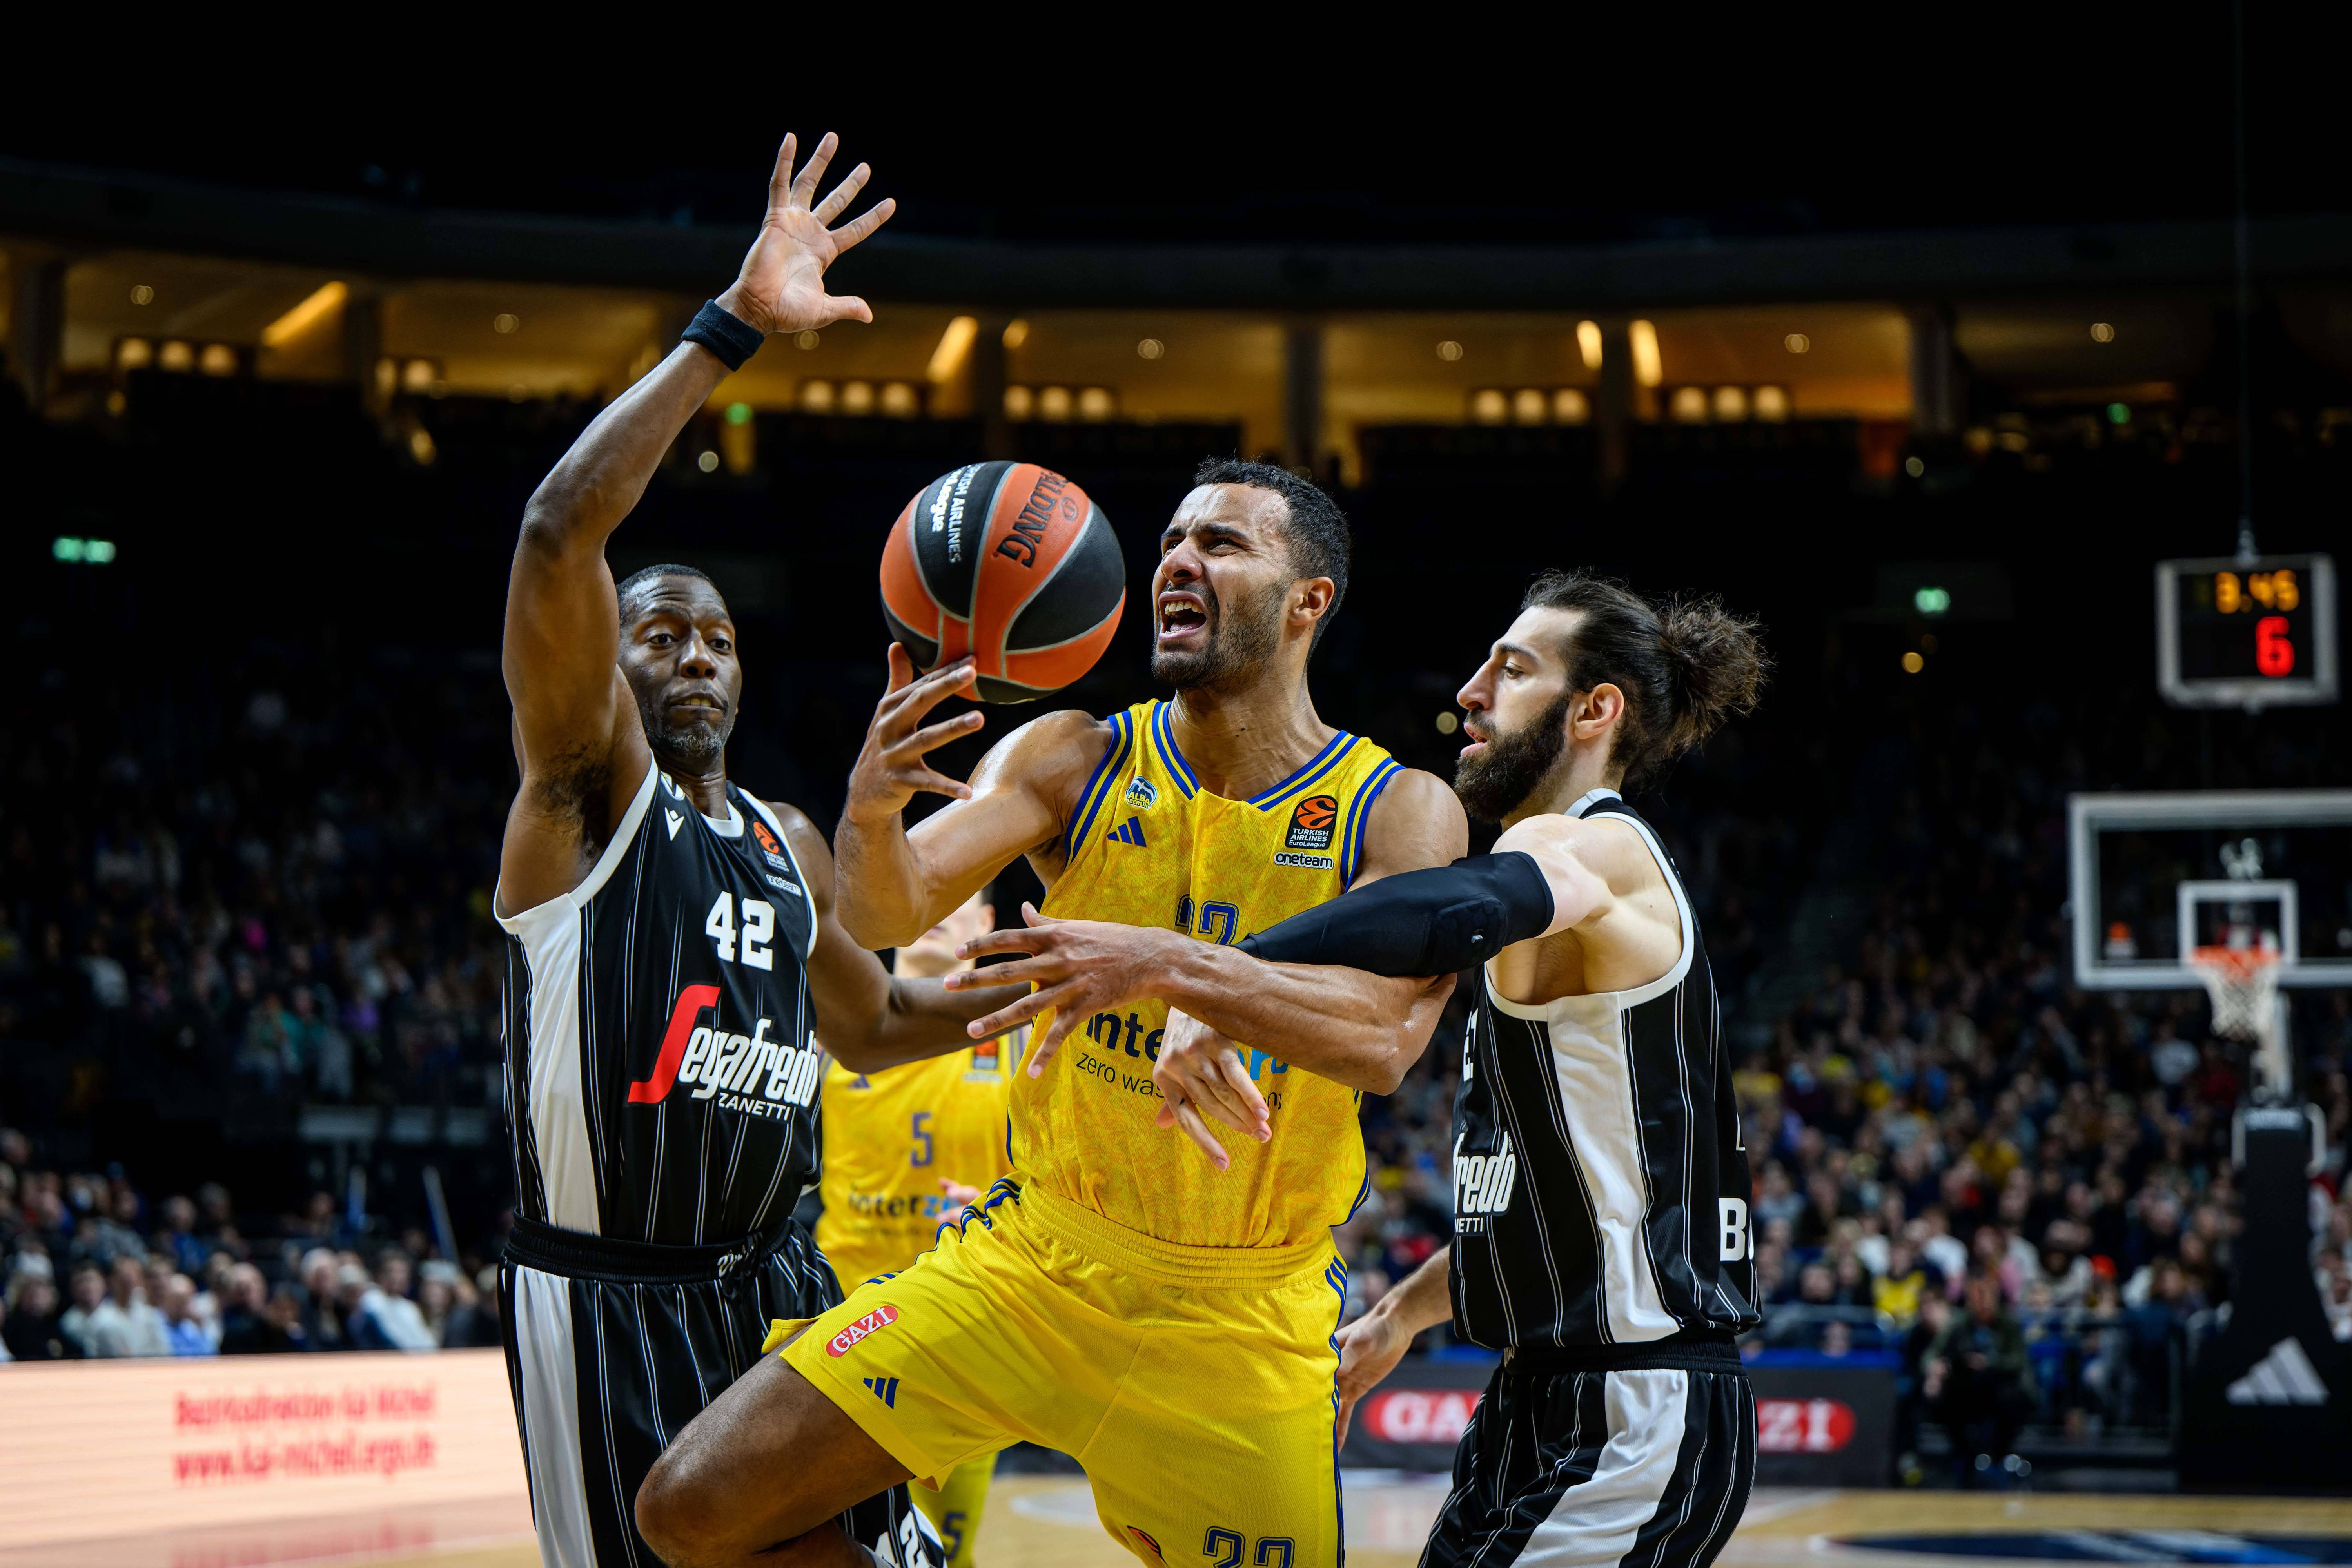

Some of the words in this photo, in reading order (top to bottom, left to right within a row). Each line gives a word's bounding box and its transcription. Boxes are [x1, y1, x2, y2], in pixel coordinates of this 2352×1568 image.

[948, 497, 965, 563] AIRLINES
[996, 471, 1069, 568] ALDING
[2256, 616, 2295, 677] 6
[1128, 792, 1150, 806] ALBA
[1129, 799, 1148, 808] BERLIN
[1292, 828, 1329, 836] TURKISH
[1275, 853, 1333, 868] oneteam
[706, 891, 775, 971] 42
[1076, 1052, 1116, 1083] zero
[718, 1093, 791, 1121] ZANETTI
[910, 1112, 933, 1168] 5
[1455, 1217, 1483, 1233] NETTI
[942, 1512, 965, 1560] 5
